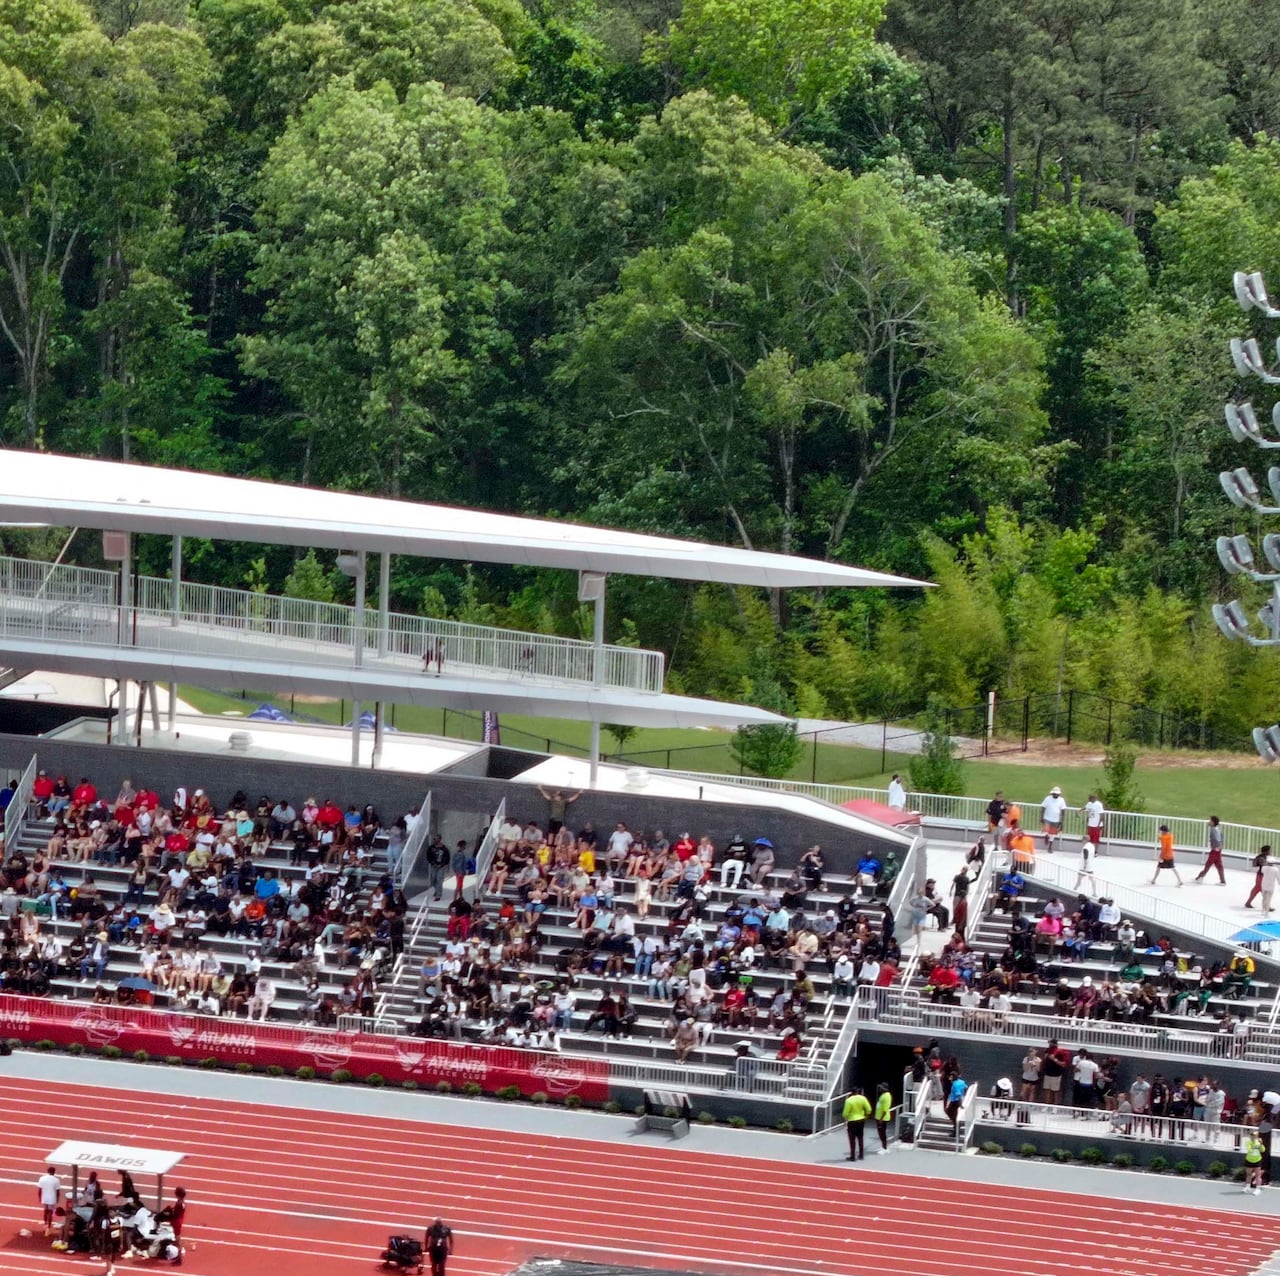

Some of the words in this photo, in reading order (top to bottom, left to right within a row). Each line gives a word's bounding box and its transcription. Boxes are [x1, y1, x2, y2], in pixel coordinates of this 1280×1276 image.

[197, 1030, 256, 1048] ATLANTA
[197, 1043, 227, 1053] TRACK
[232, 1046, 256, 1056] CLUB
[427, 1054, 488, 1073] ATLANTA
[427, 1068, 457, 1079] TRACK
[462, 1072, 487, 1081] CLUB
[75, 1152, 148, 1168] DAWGS
